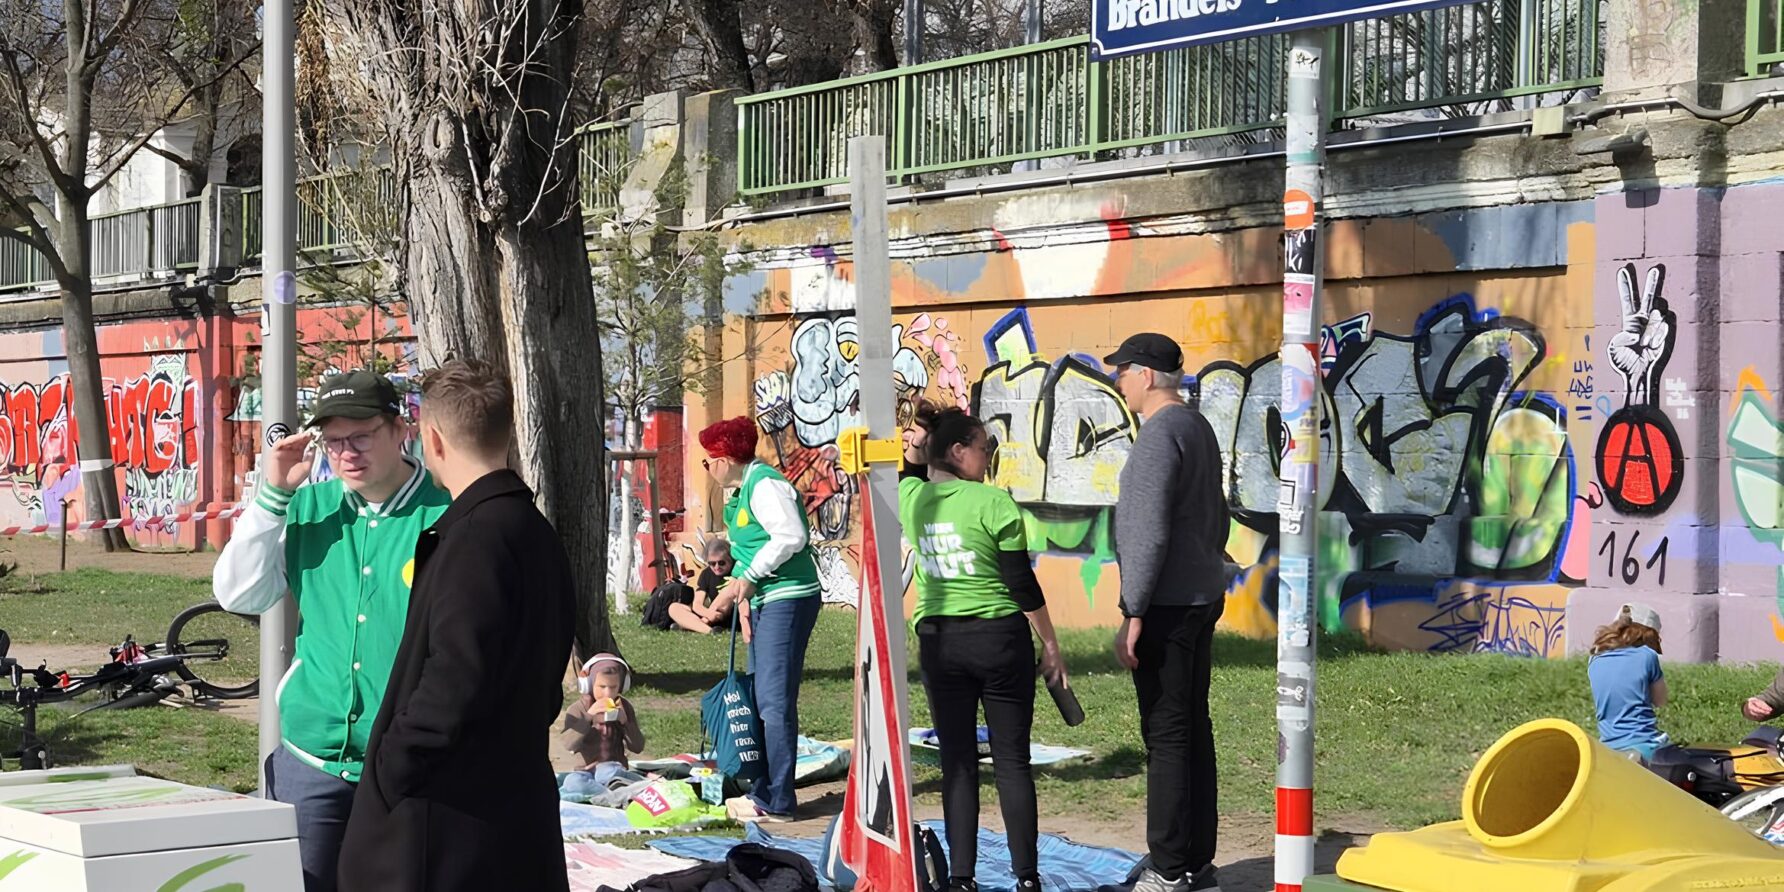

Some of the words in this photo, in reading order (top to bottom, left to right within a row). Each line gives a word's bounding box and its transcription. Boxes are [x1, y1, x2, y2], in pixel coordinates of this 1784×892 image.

[1107, 0, 1241, 32] Brane
[918, 534, 964, 555] NUR
[1598, 529, 1669, 586] 161
